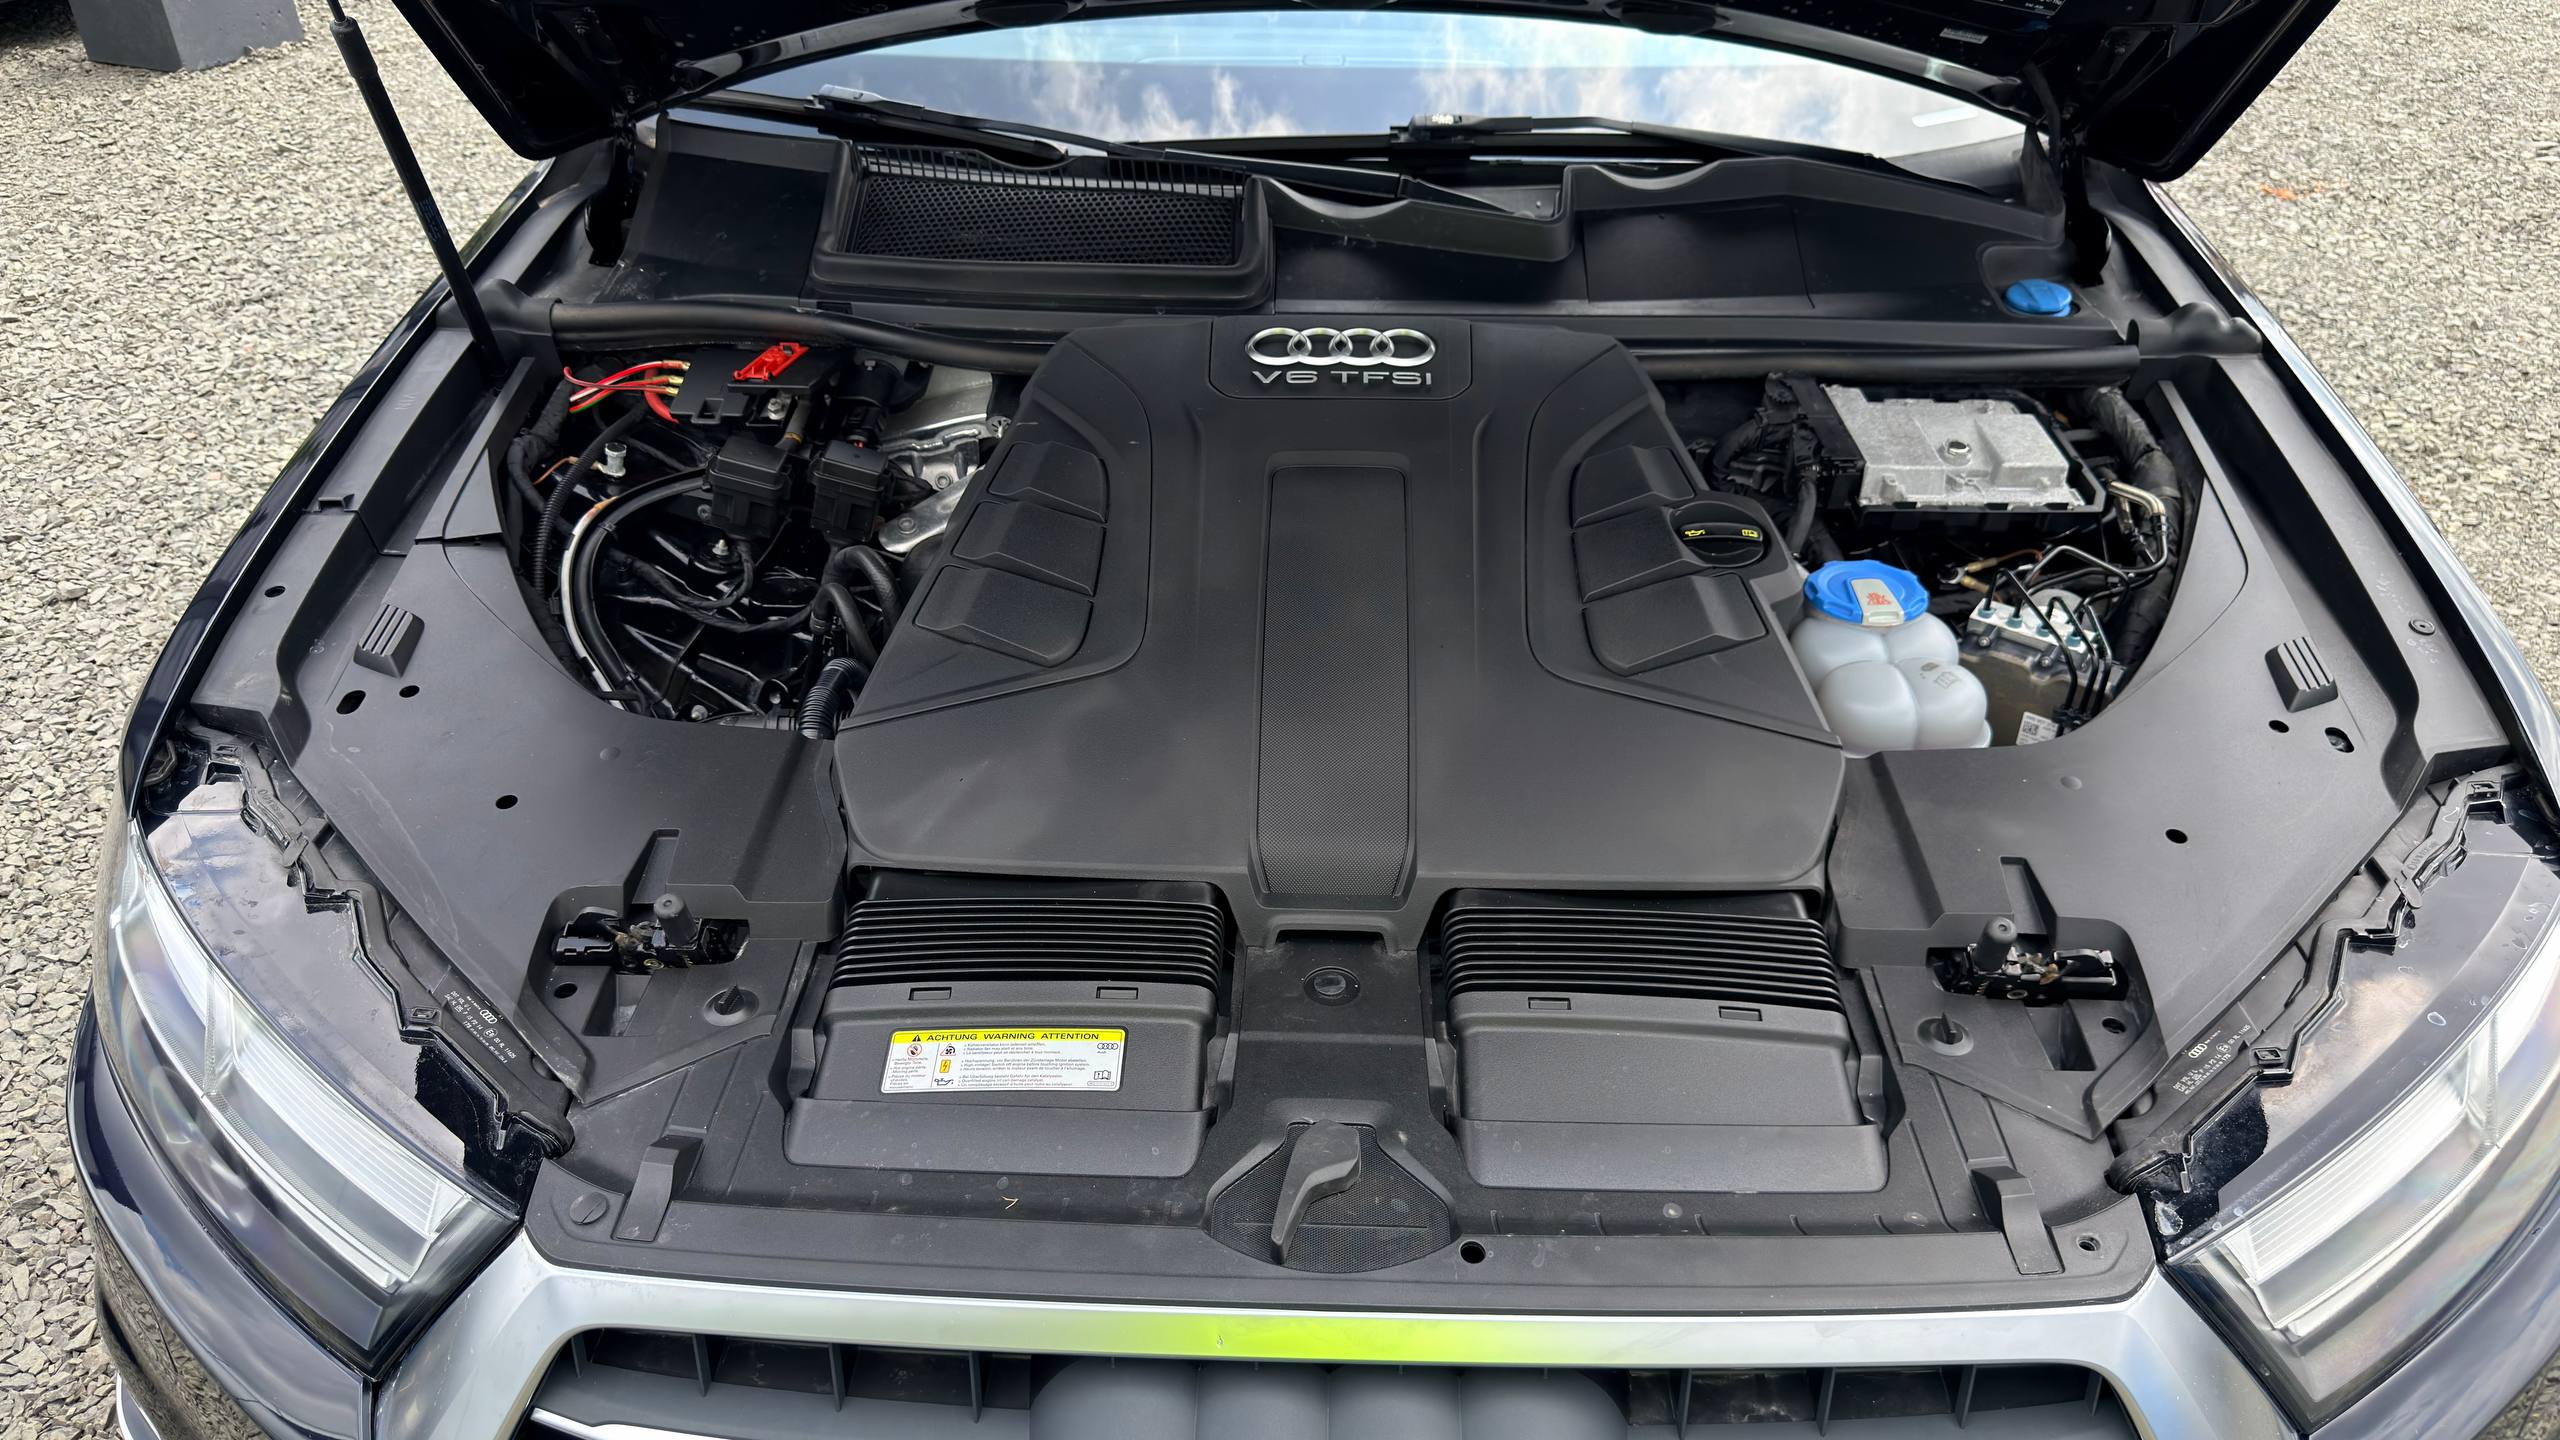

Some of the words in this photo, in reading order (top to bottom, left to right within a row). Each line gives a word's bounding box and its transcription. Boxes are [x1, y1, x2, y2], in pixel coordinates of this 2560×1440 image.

[1252, 370, 1318, 384] V6
[1330, 370, 1432, 385] TFSI
[926, 1033, 978, 1041] ACHTUNG
[983, 1032, 1036, 1040] WARNING
[1040, 1032, 1100, 1040] ATTENTION
